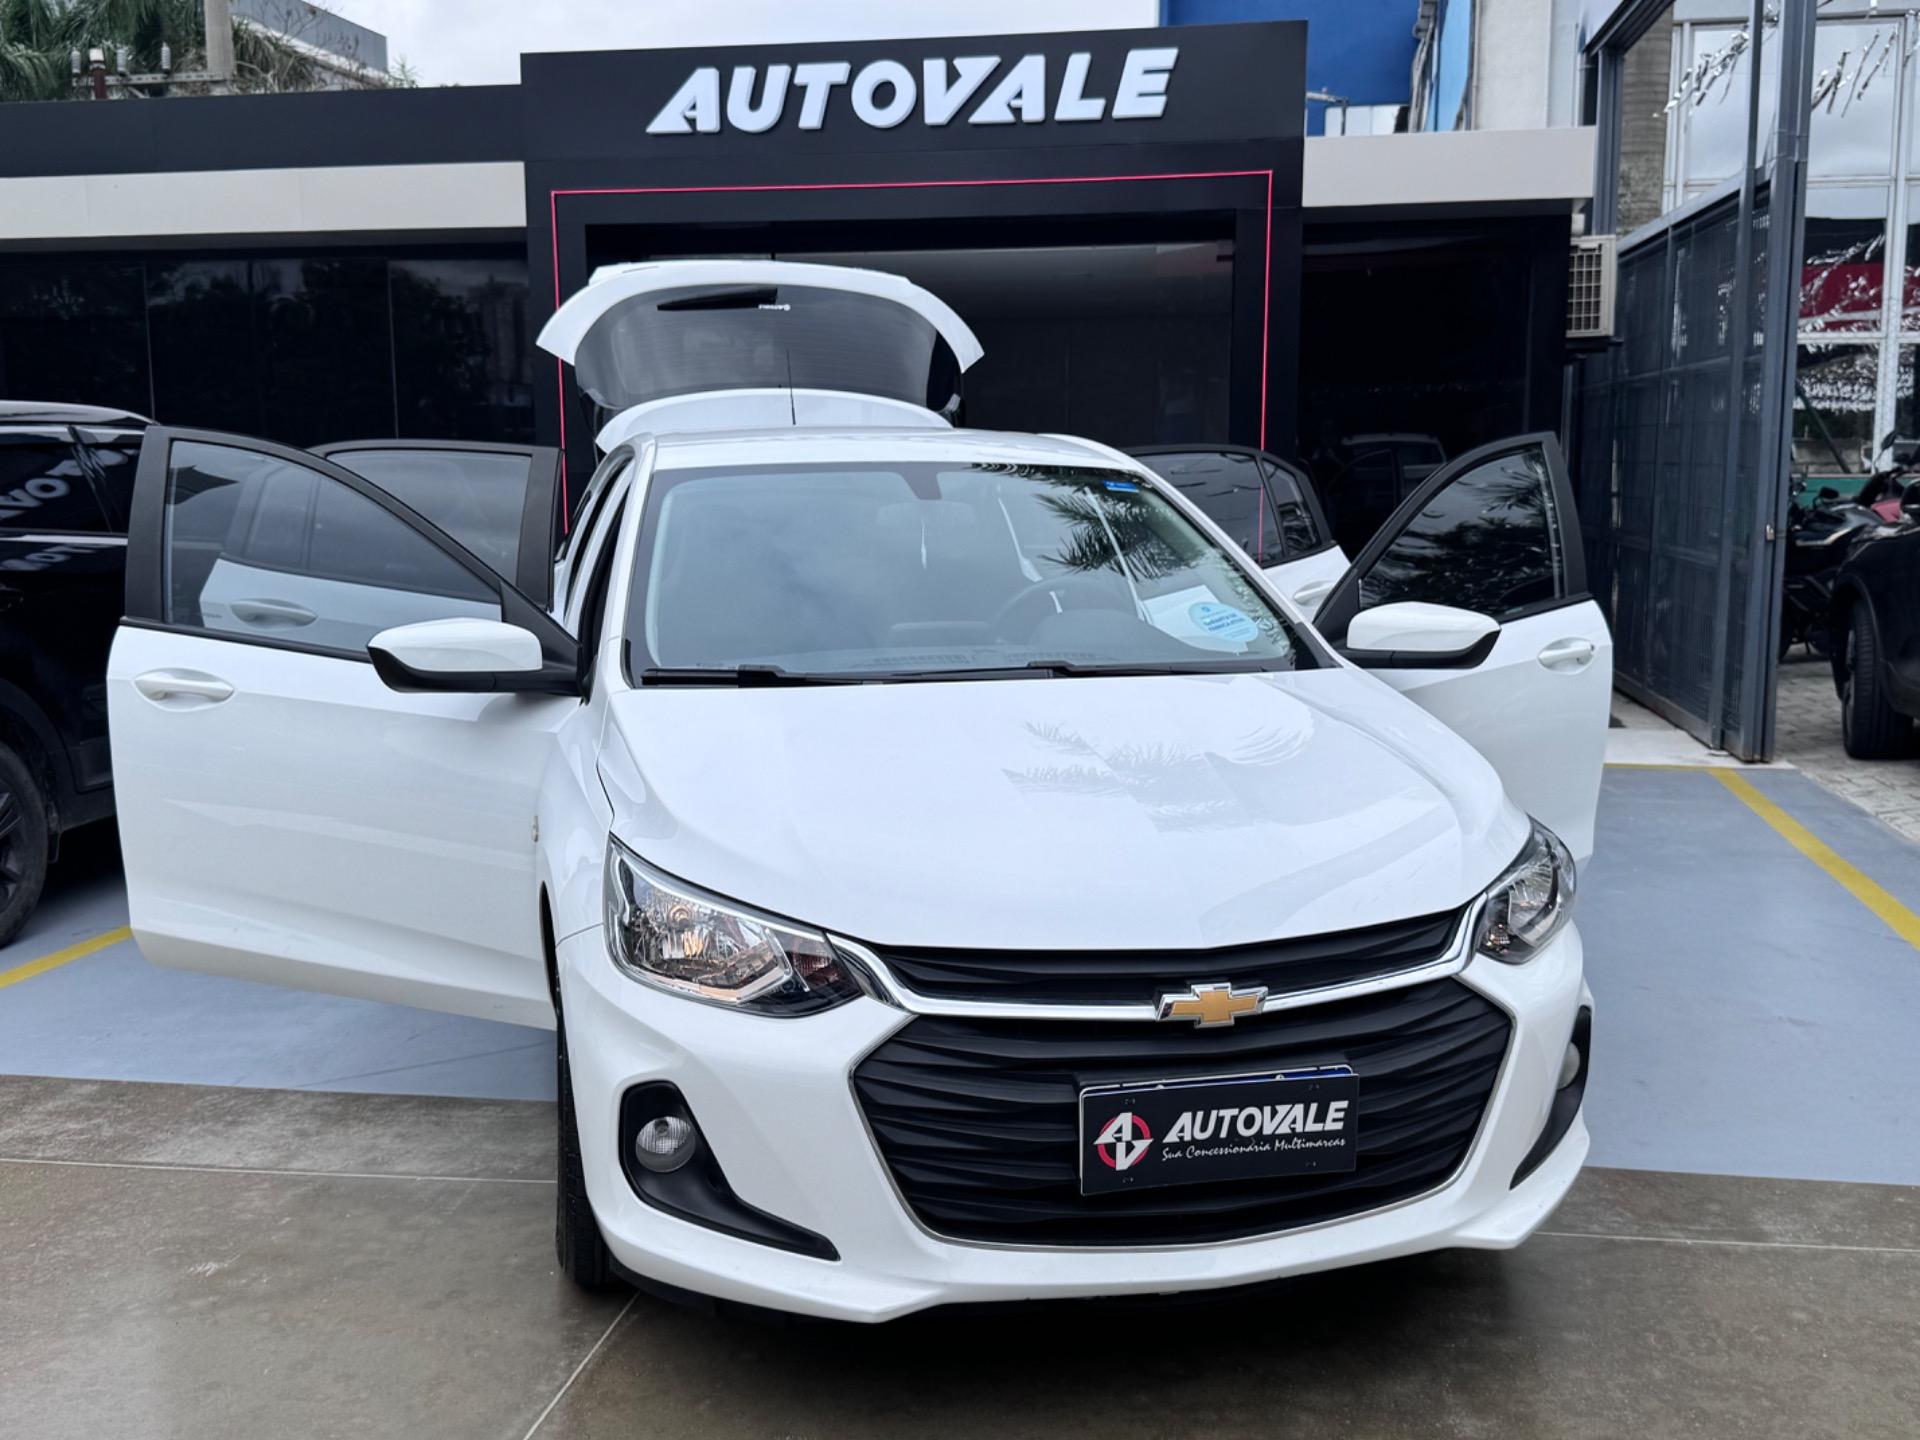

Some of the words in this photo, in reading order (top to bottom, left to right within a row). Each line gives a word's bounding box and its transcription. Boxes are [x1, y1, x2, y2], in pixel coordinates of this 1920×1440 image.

[646, 47, 1179, 134] AUTOVALE
[1162, 1100, 1349, 1144] AUTOVALE
[1161, 1146, 1183, 1161] Sua
[1185, 1138, 1271, 1159] Concessionária
[1274, 1137, 1346, 1152] Multimarcas
